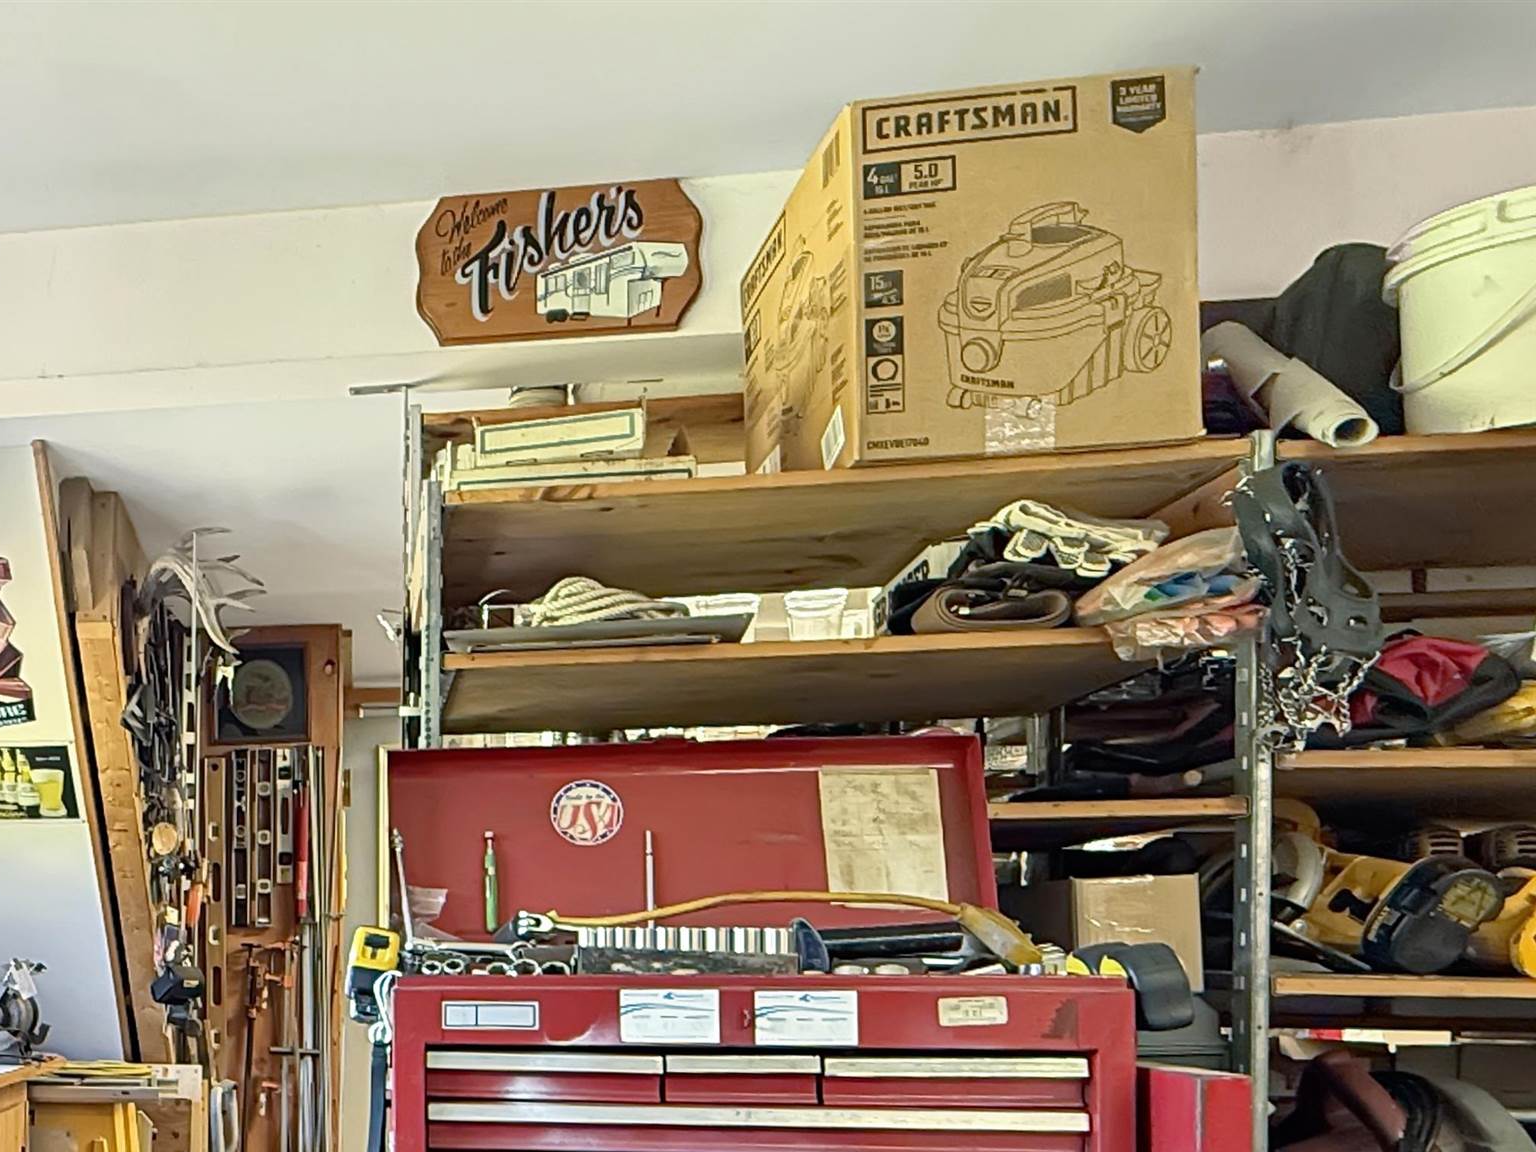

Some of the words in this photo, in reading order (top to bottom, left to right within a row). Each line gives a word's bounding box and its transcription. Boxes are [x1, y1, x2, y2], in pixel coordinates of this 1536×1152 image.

[875, 98, 1062, 140] CRAFTSMAN
[866, 167, 879, 185] 4
[914, 163, 938, 180] 5.0
[435, 198, 508, 240] Welcome
[457, 185, 645, 321] Fisher's
[558, 801, 616, 840] USA
